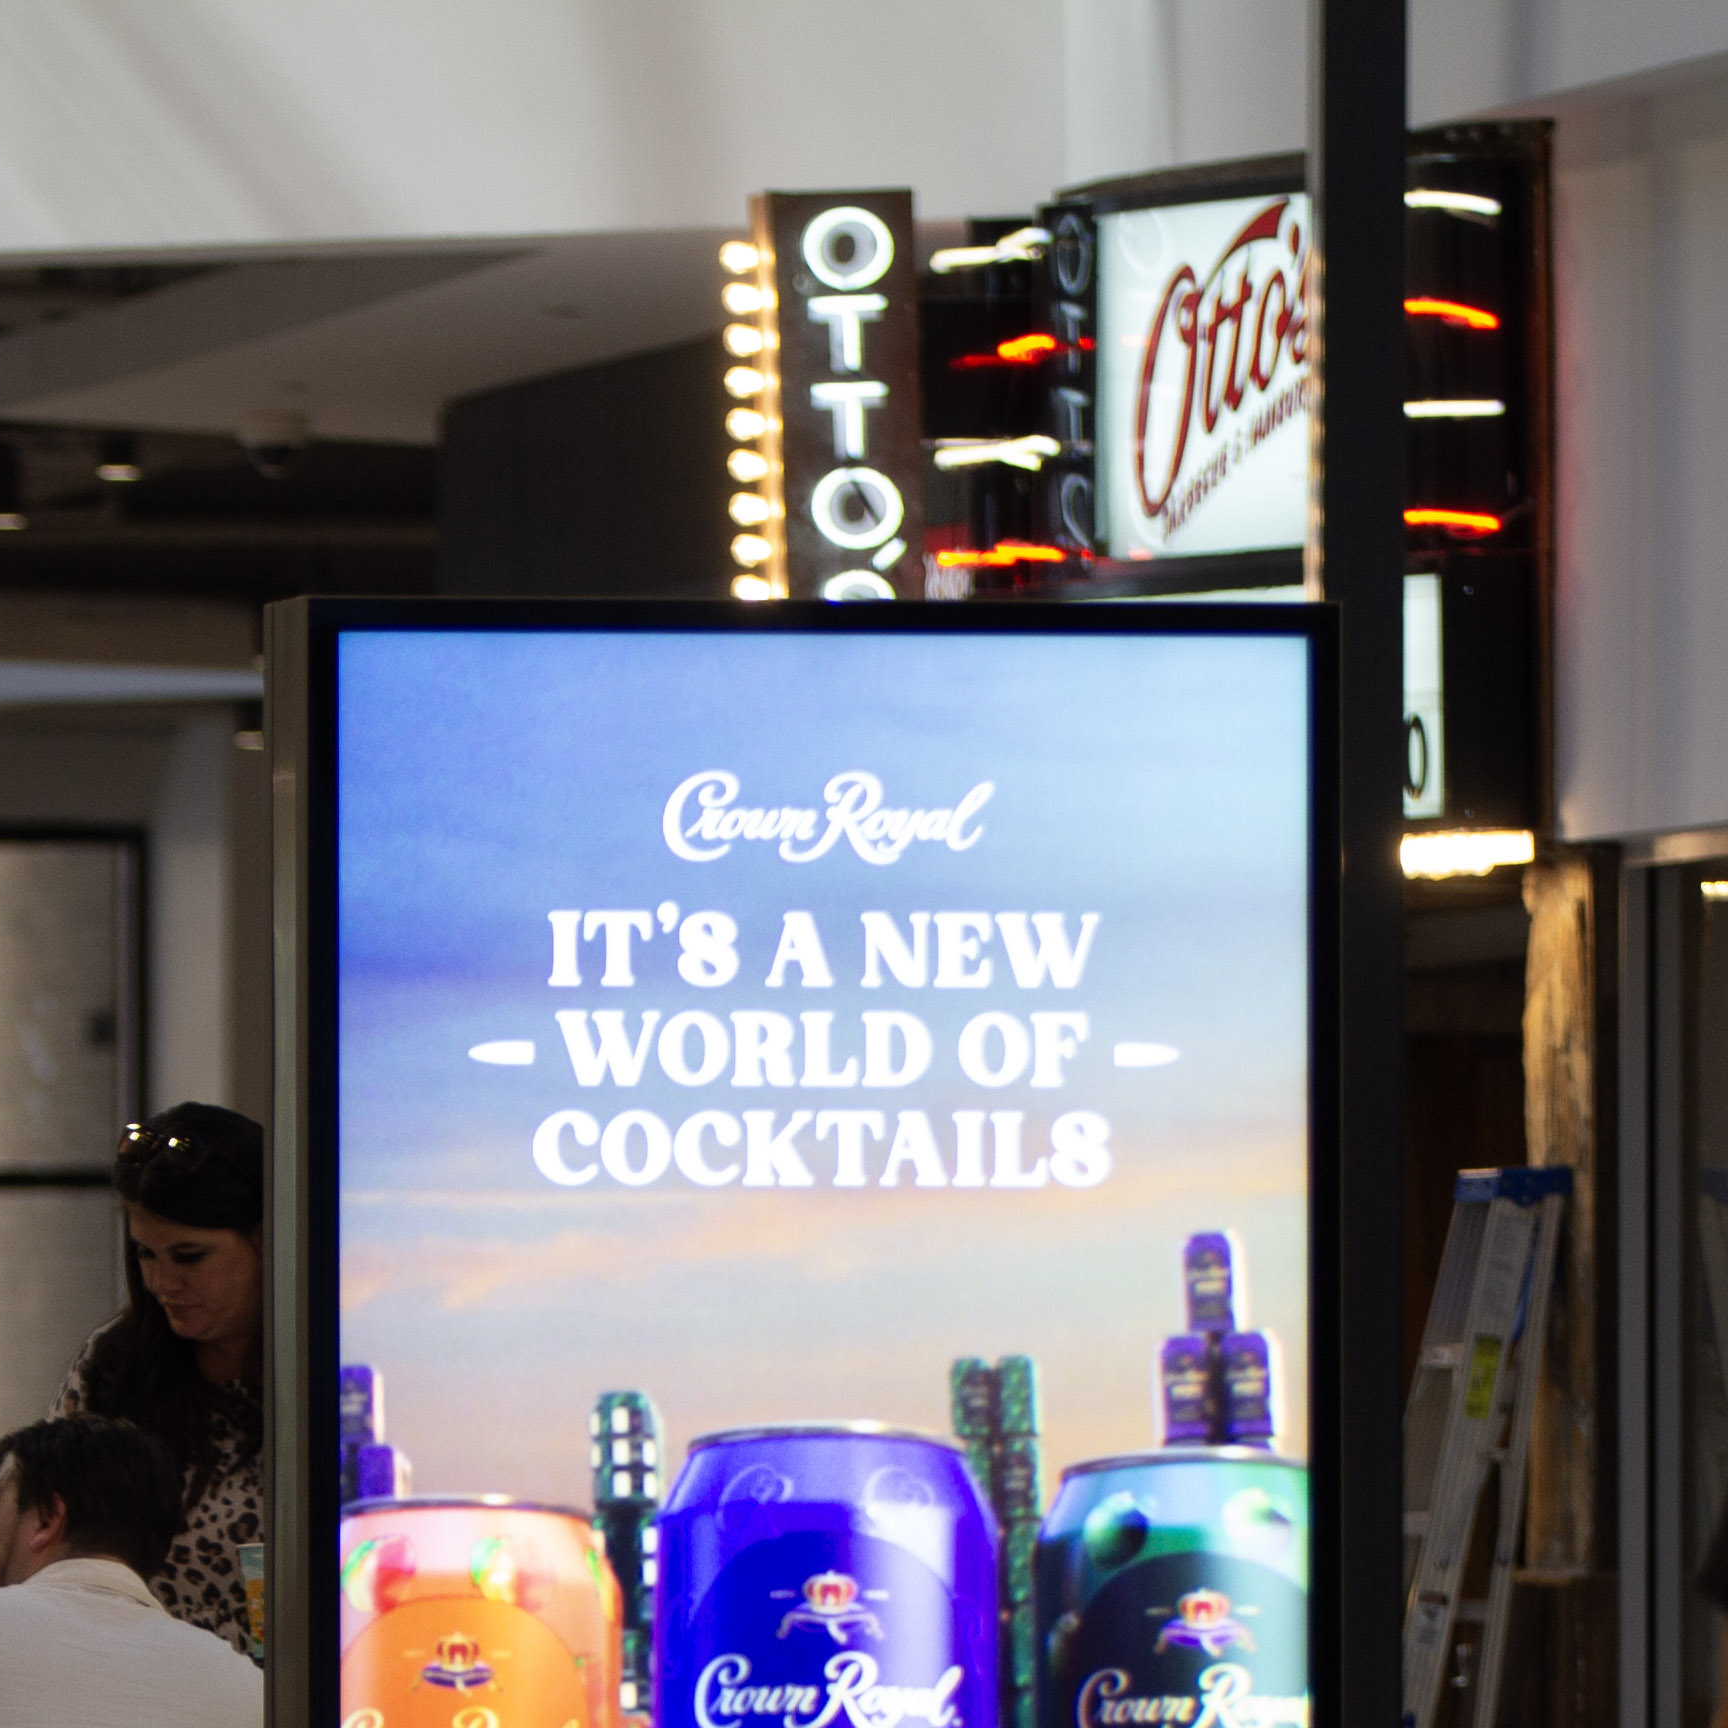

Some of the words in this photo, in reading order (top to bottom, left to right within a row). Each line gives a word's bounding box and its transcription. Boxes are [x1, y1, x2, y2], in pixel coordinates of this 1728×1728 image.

[662, 770, 819, 862] Crown
[778, 770, 996, 866] Royal
[546, 899, 739, 990] IT'S
[763, 910, 834, 990] A
[860, 910, 1100, 990] NEW
[554, 1009, 933, 1089] WORLD
[957, 1009, 1089, 1089] OF
[531, 1108, 1113, 1189] COCKTAILS
